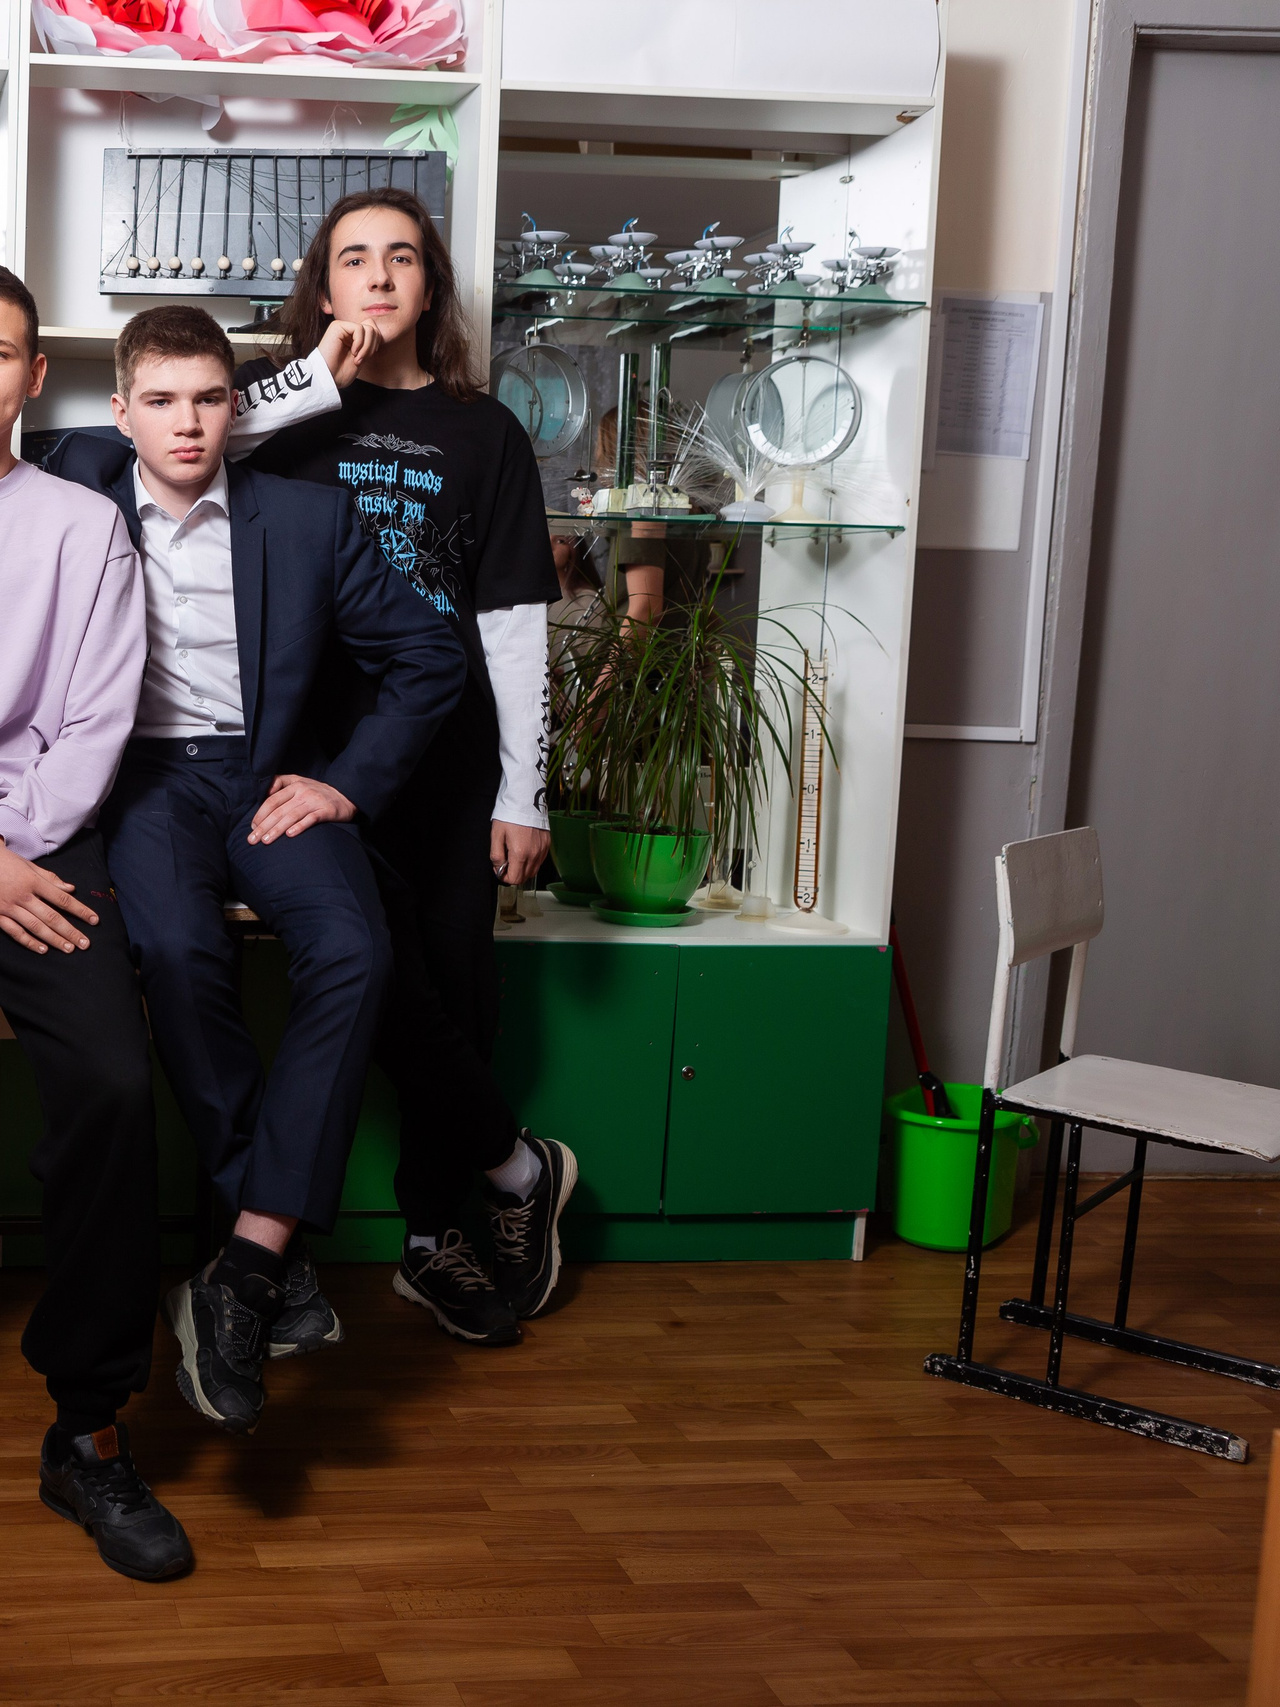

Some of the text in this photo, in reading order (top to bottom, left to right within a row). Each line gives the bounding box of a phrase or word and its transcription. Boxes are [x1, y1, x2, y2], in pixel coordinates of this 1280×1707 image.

[338, 459, 444, 496] mystical moods
[402, 500, 426, 526] you
[811, 673, 819, 685] 2
[803, 893, 811, 904] 2
